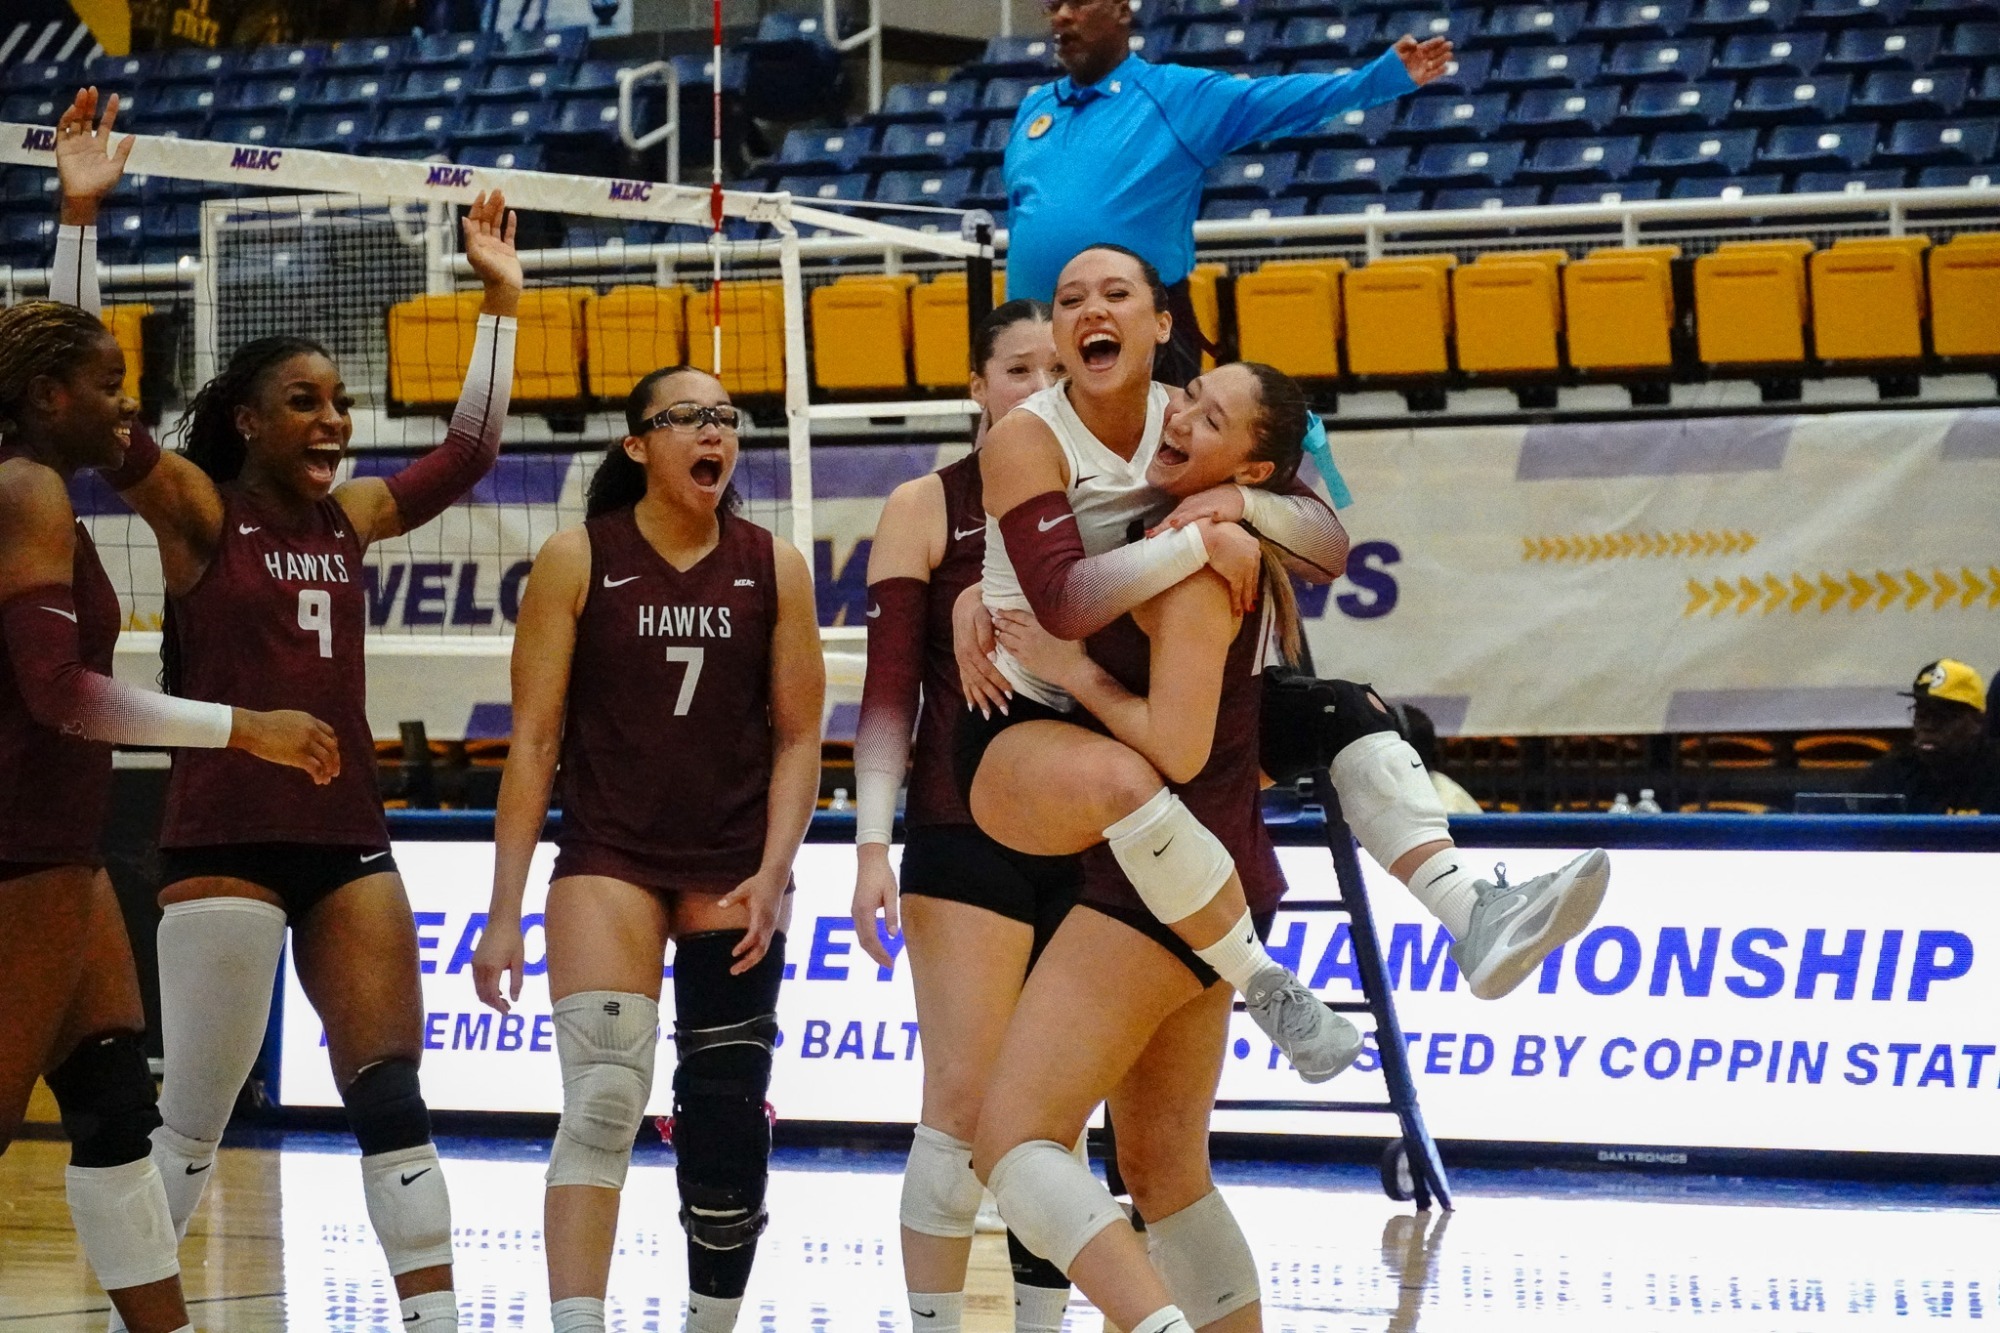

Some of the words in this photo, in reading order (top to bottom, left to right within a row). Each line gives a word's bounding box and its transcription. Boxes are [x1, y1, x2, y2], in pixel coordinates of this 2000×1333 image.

[22, 127, 57, 153] ME
[230, 147, 282, 171] MEAC
[425, 166, 473, 189] MEAC
[608, 181, 653, 202] MEAC
[264, 551, 349, 583] HAWKS
[363, 561, 533, 626] WELC
[298, 589, 332, 659] 9
[638, 605, 732, 638] HAWKS
[666, 646, 705, 717] 7
[1511, 1035, 1587, 1078] BY
[1600, 1037, 1829, 1084] COPPIN
[1843, 1043, 2000, 1089] STAT
